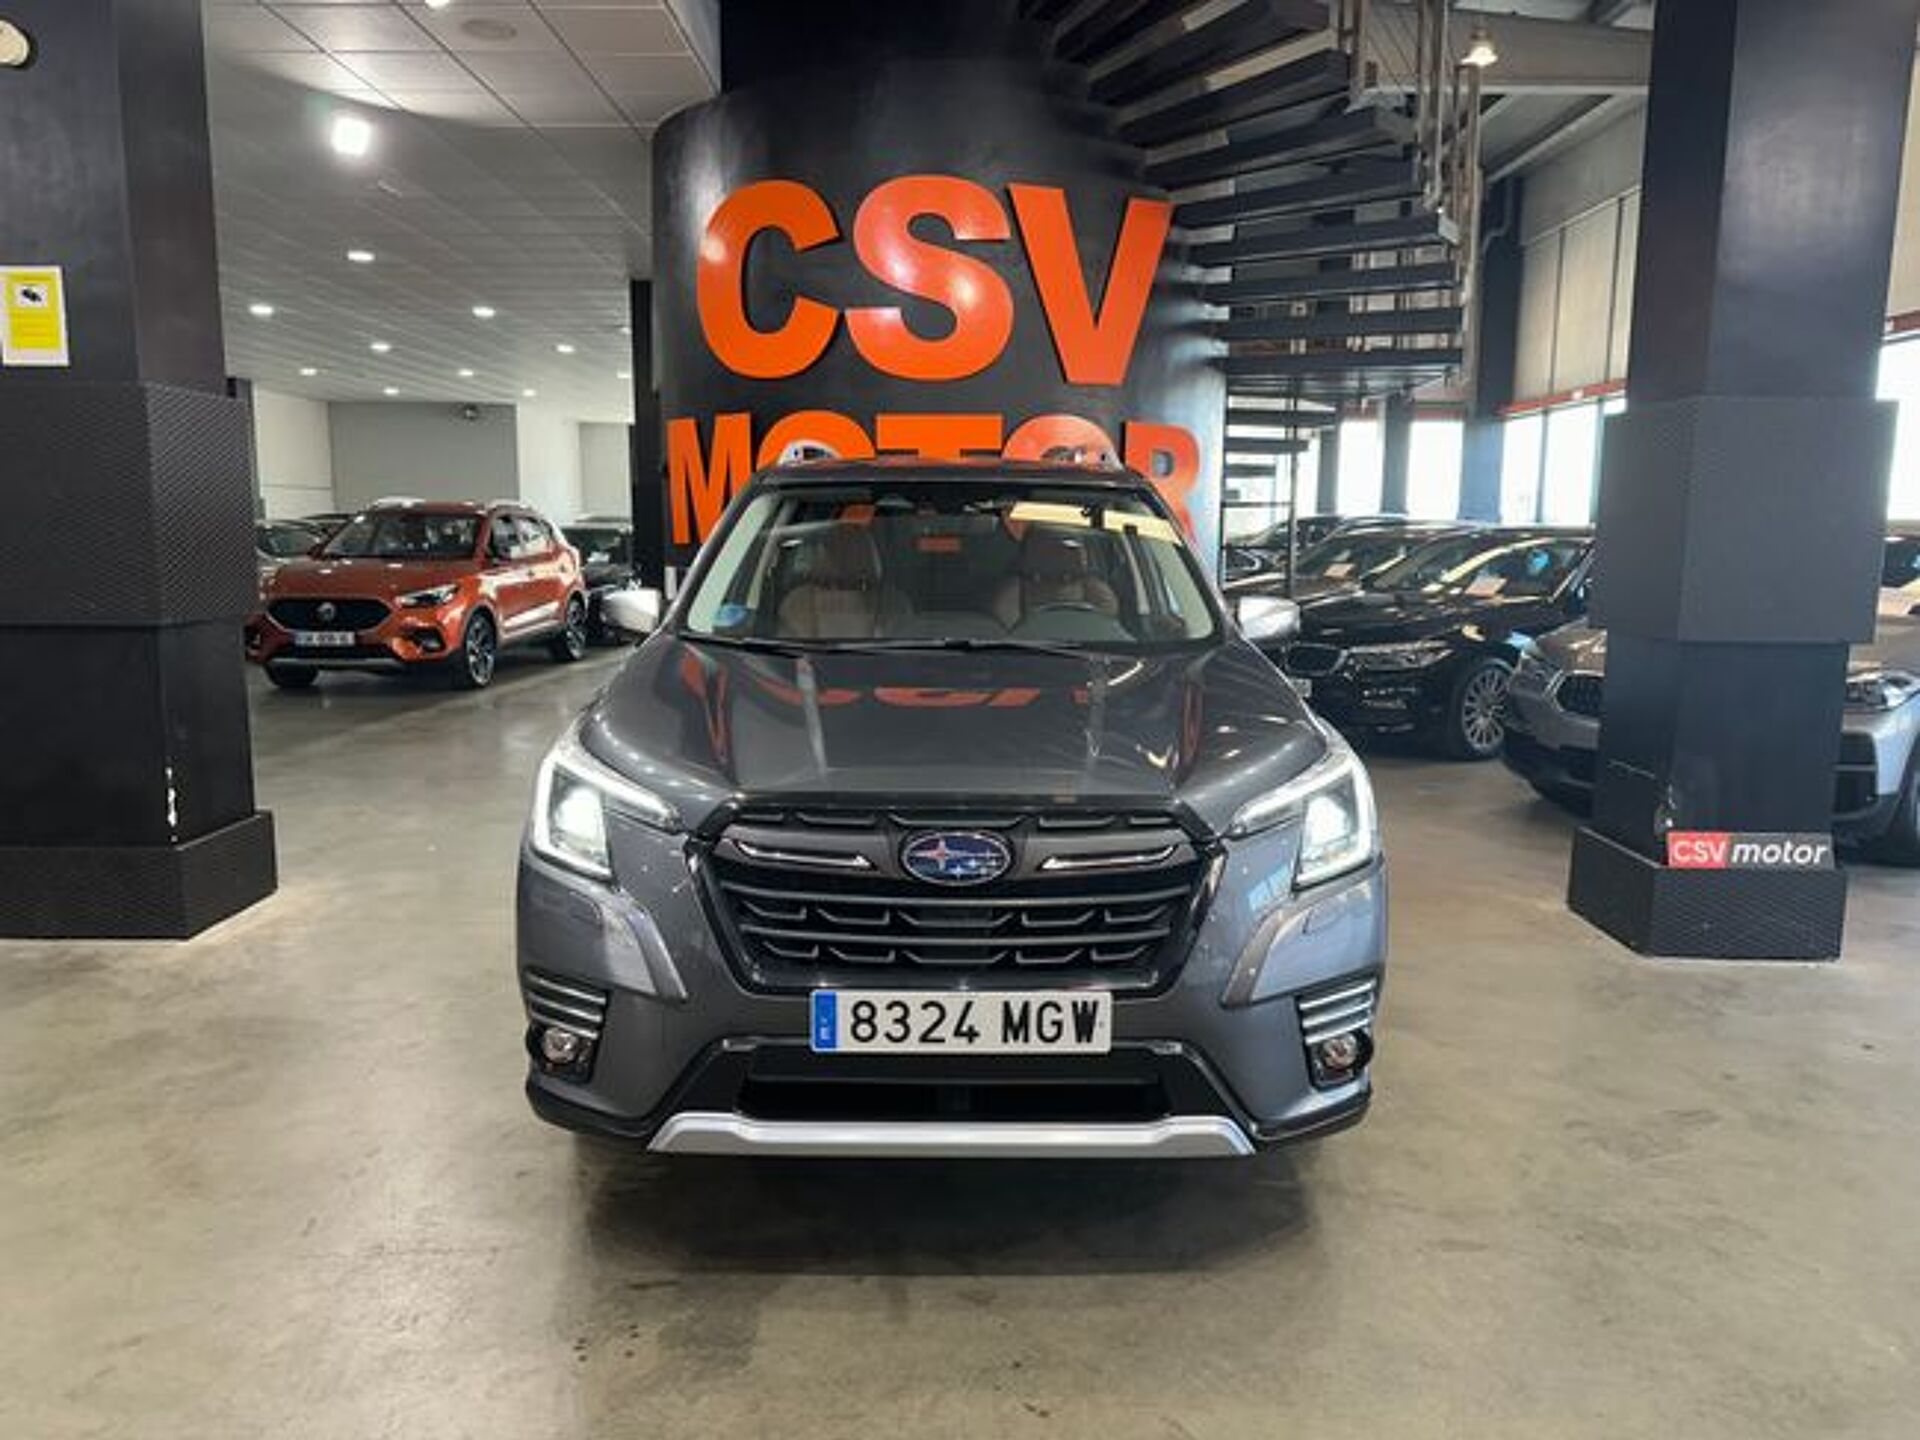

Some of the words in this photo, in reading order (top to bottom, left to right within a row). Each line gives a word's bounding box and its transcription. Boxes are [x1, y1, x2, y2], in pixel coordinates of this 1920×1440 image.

[696, 174, 1175, 384] CSV
[1673, 840, 1727, 864] CSV
[1731, 839, 1827, 864] motor
[851, 1000, 980, 1043] 8324
[1003, 1000, 1099, 1043] MGW
